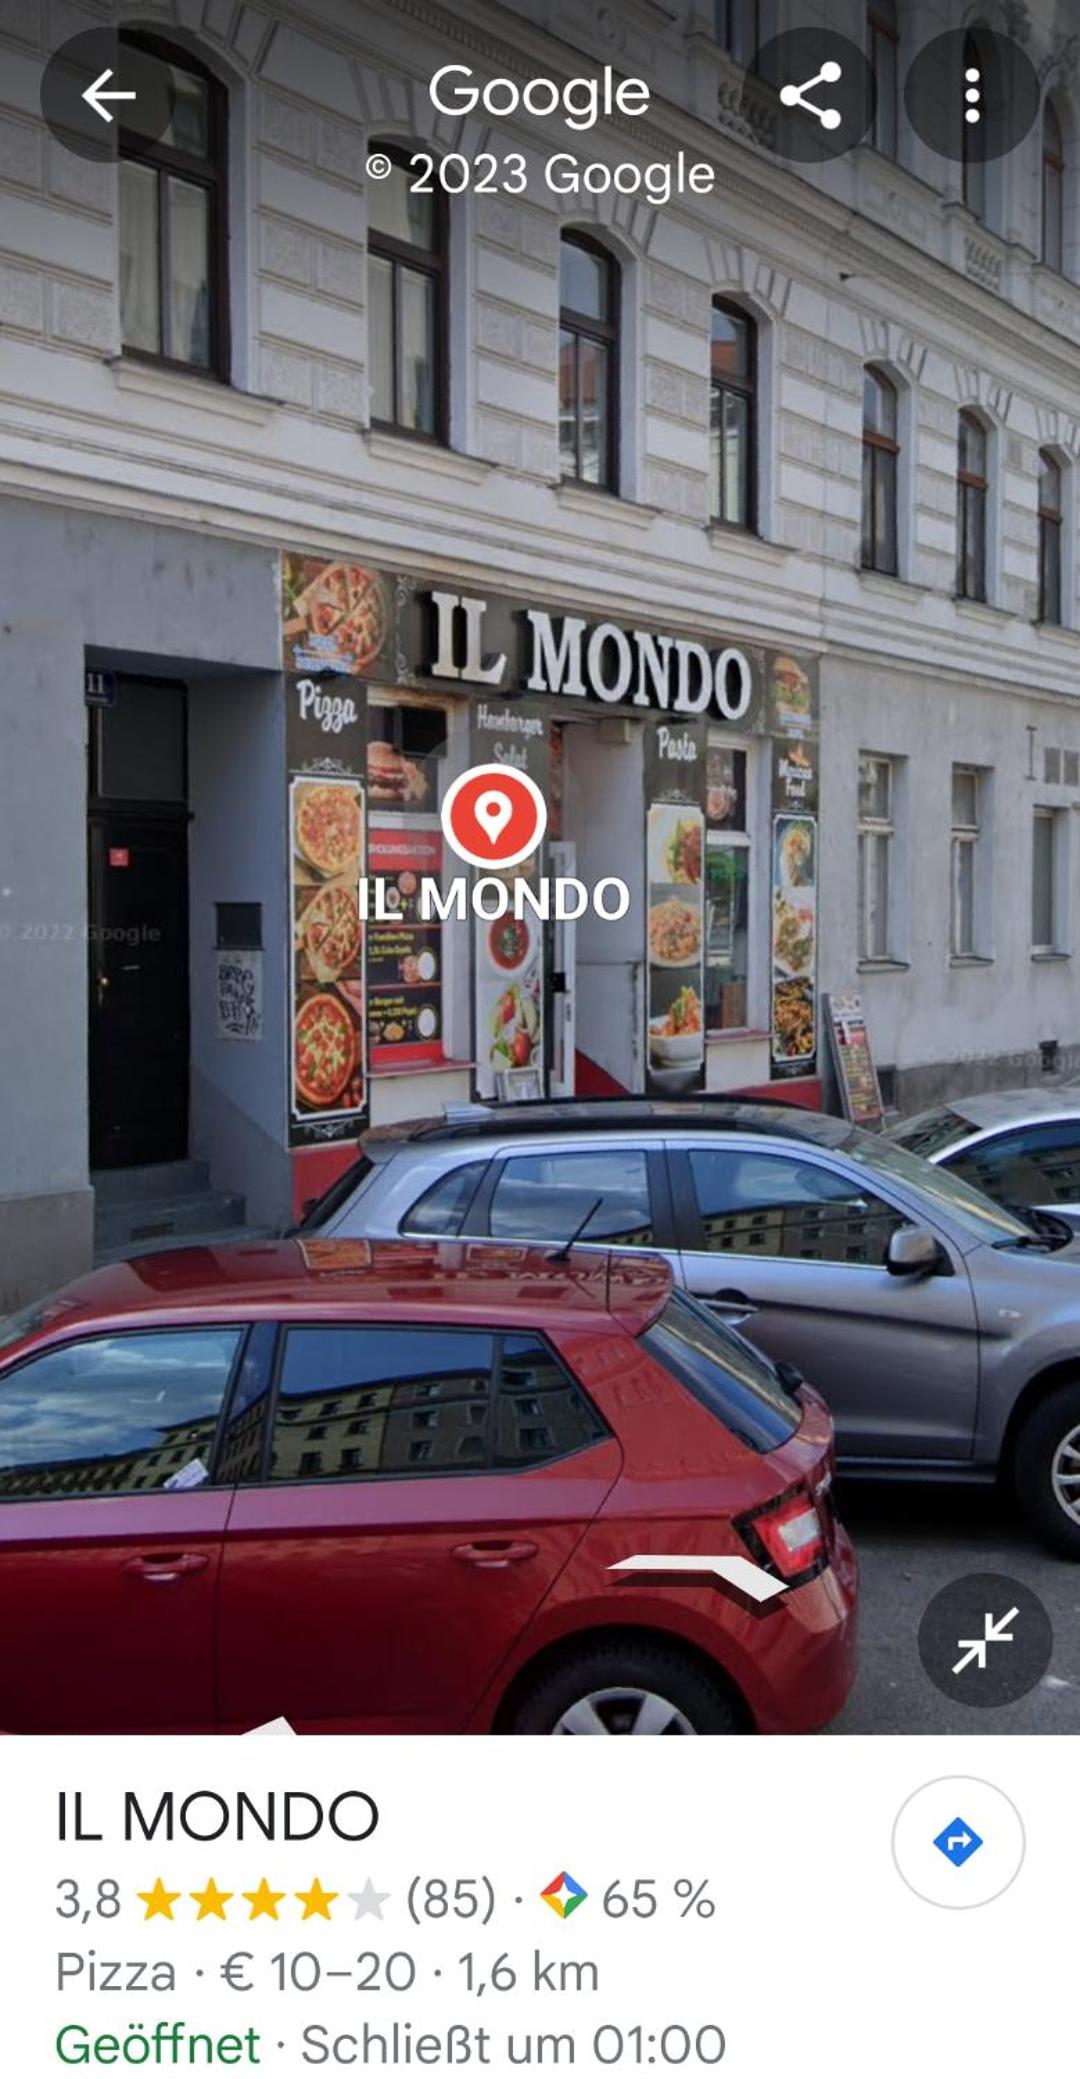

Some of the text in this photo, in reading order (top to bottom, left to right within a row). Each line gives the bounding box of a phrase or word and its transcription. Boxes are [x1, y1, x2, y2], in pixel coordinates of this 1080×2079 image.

[431, 591, 752, 721] IL MONDO
[296, 679, 358, 734] Pizza
[656, 726, 698, 761] Pasta
